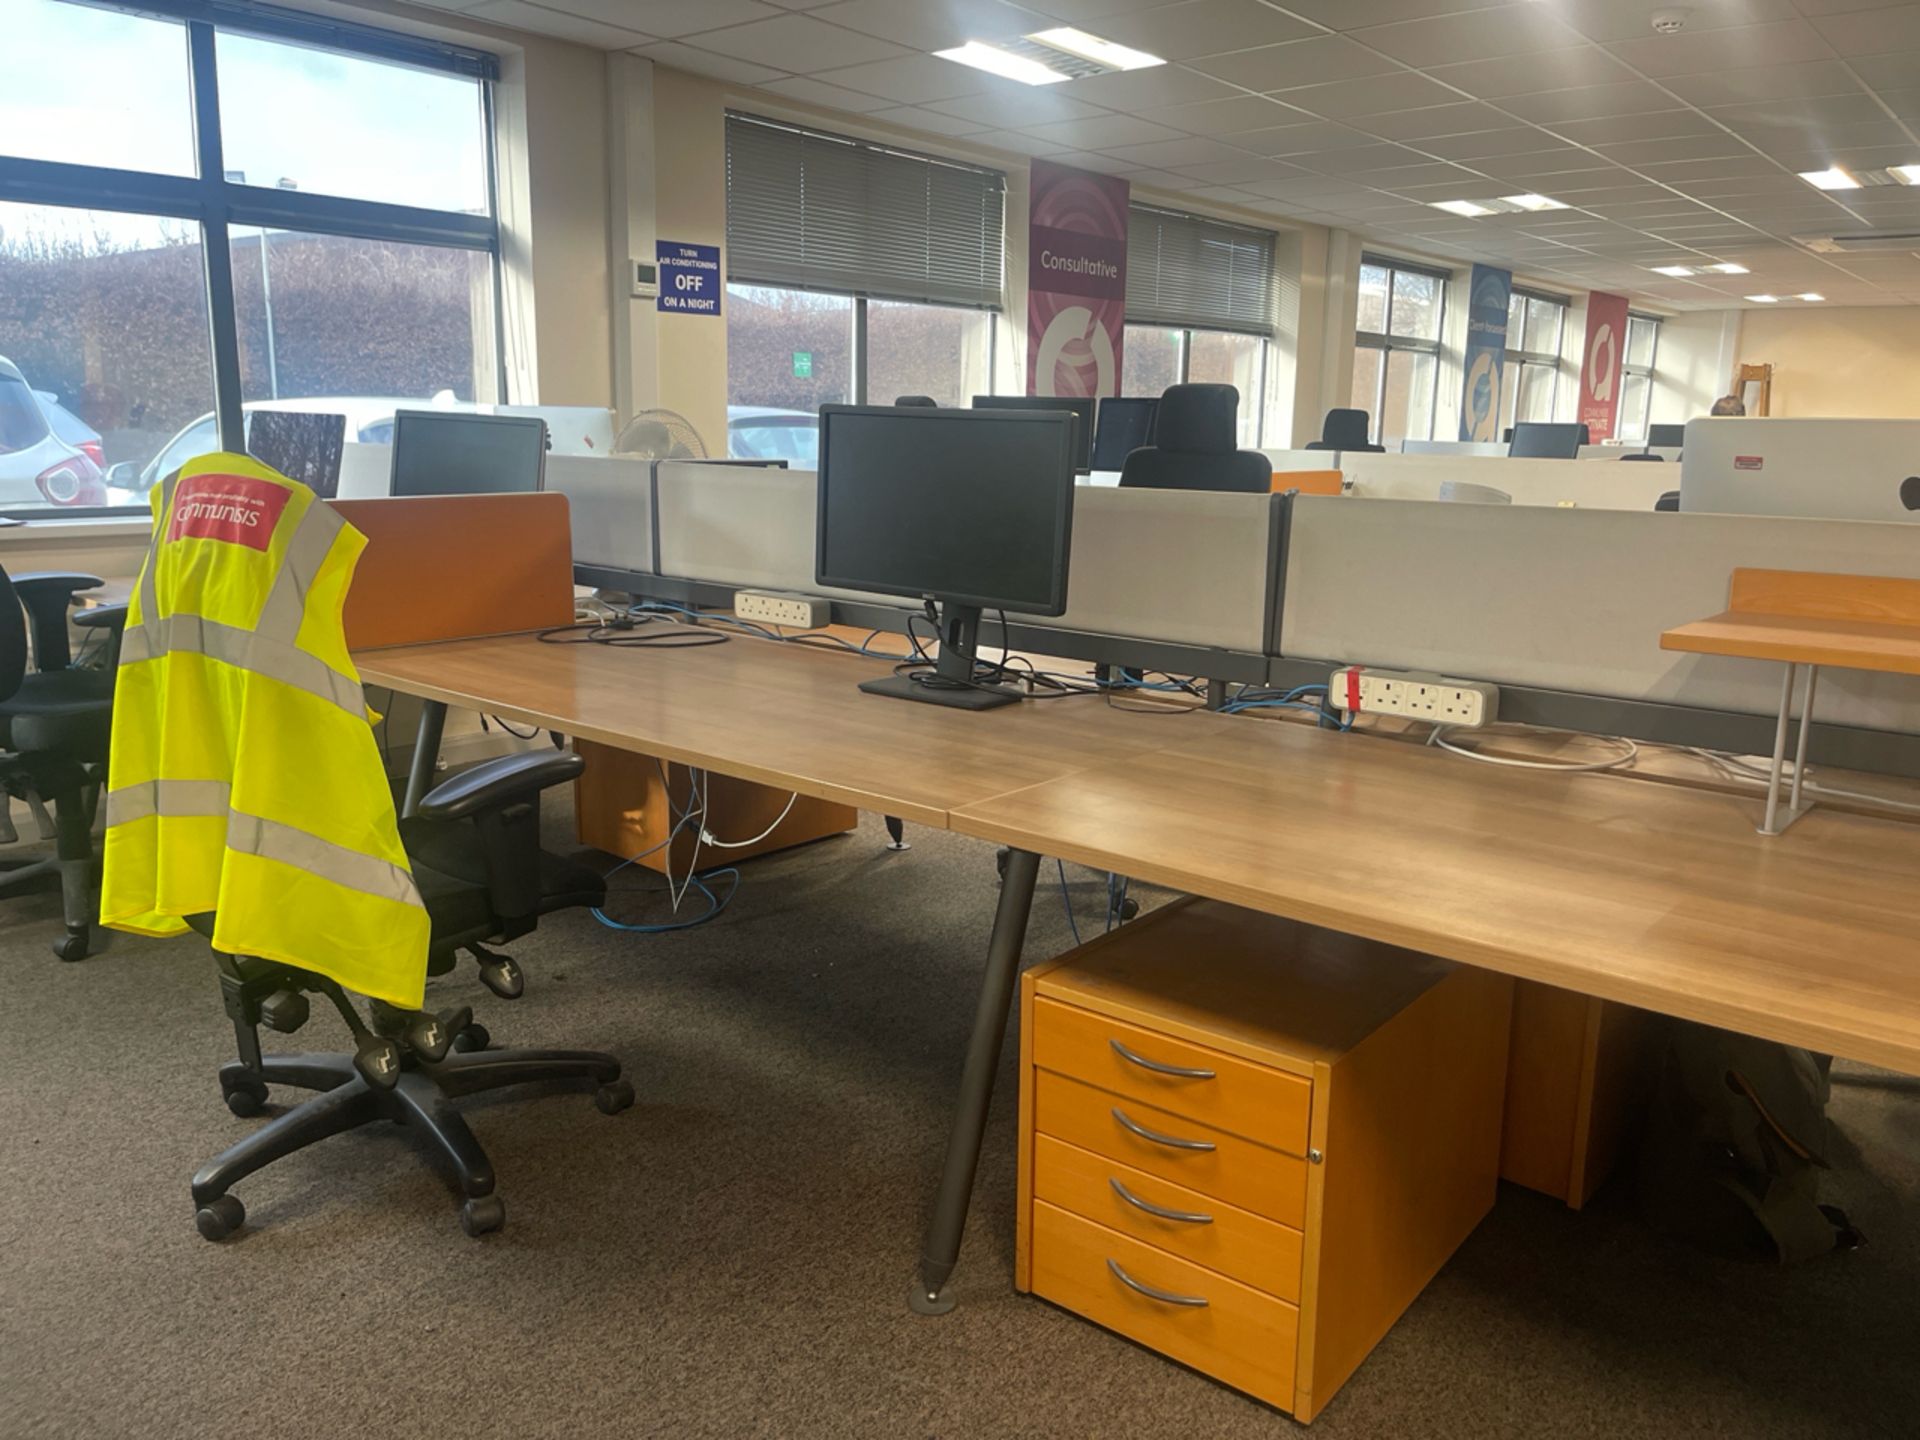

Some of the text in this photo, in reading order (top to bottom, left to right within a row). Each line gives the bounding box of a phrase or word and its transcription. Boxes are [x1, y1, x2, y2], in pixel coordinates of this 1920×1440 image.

[680, 248, 698, 257] TURN
[672, 258, 717, 270] CONDITIONING
[1041, 250, 1117, 278] Consultative
[675, 274, 703, 291] OFF
[664, 296, 715, 310] ON A NIGHT
